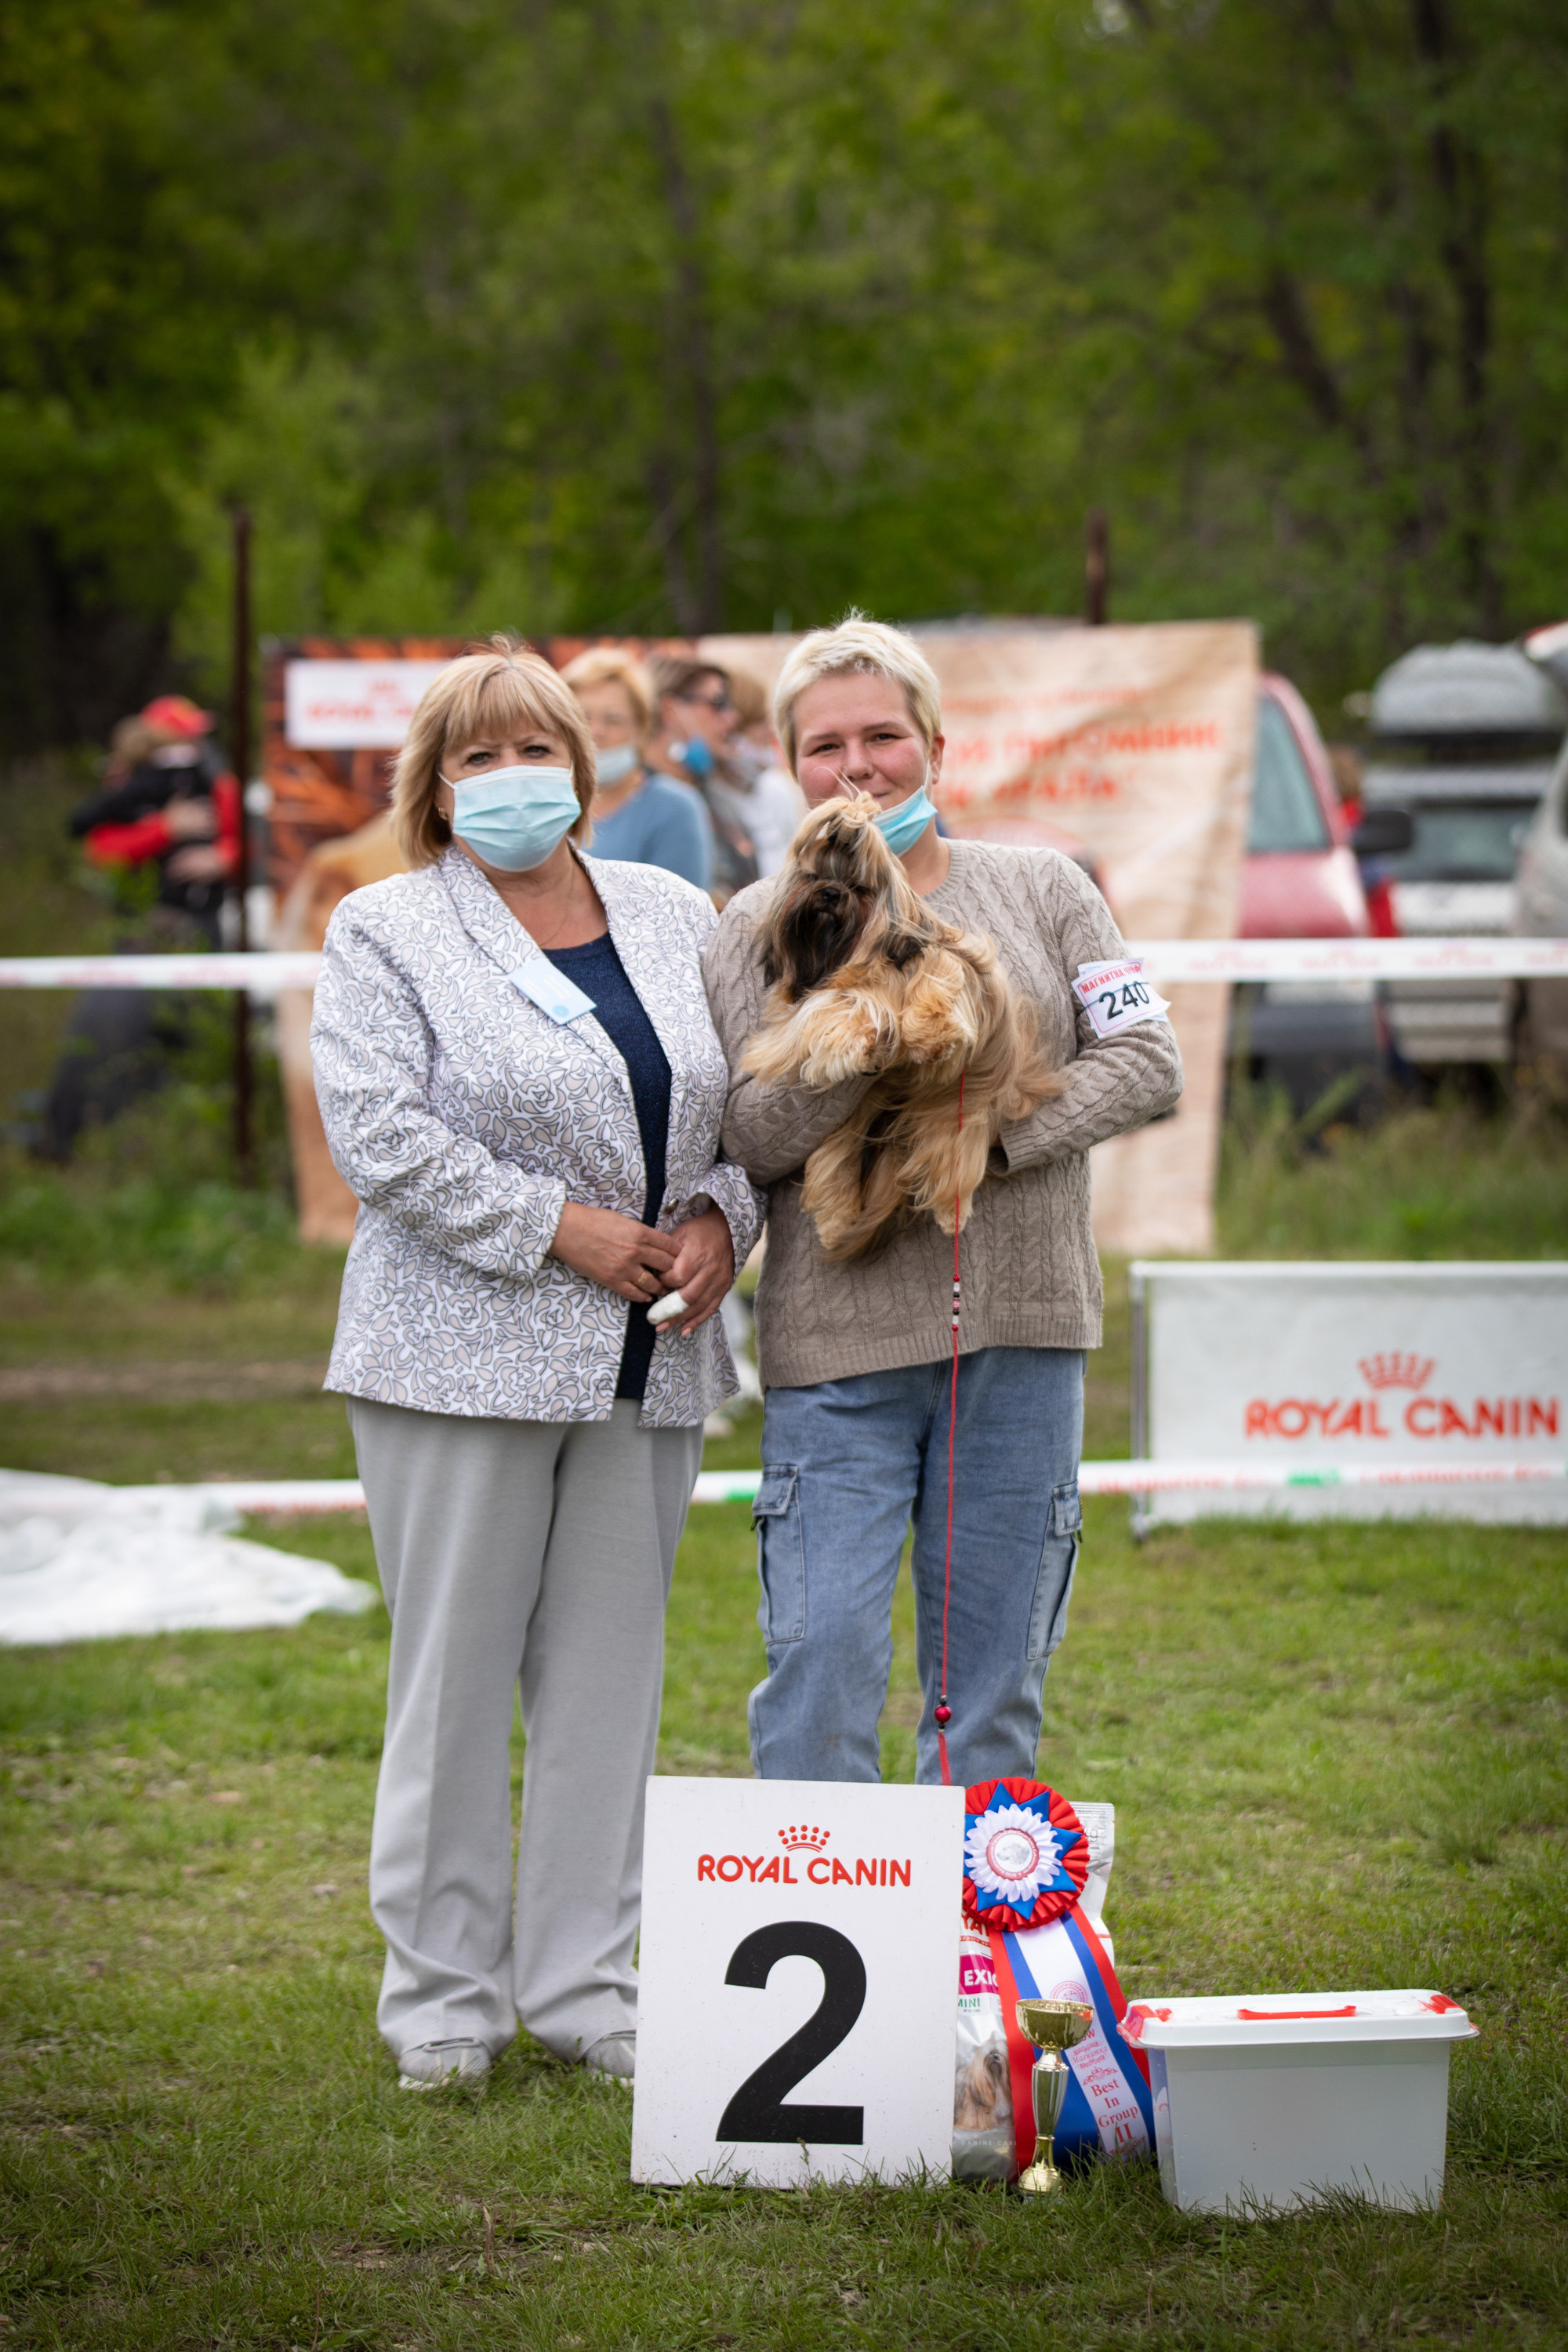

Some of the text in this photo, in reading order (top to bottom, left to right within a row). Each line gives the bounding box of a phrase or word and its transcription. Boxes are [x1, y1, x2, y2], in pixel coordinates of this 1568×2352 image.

[1098, 981, 1149, 1020] 240
[1245, 1397, 1559, 1439] ROYAL CANIN
[697, 1853, 912, 1887] ROYAL CANIN
[716, 1921, 867, 2146] 2
[1091, 2078, 1120, 2097] Best
[1104, 2097, 1120, 2109] In
[1098, 2106, 1138, 2128] Group
